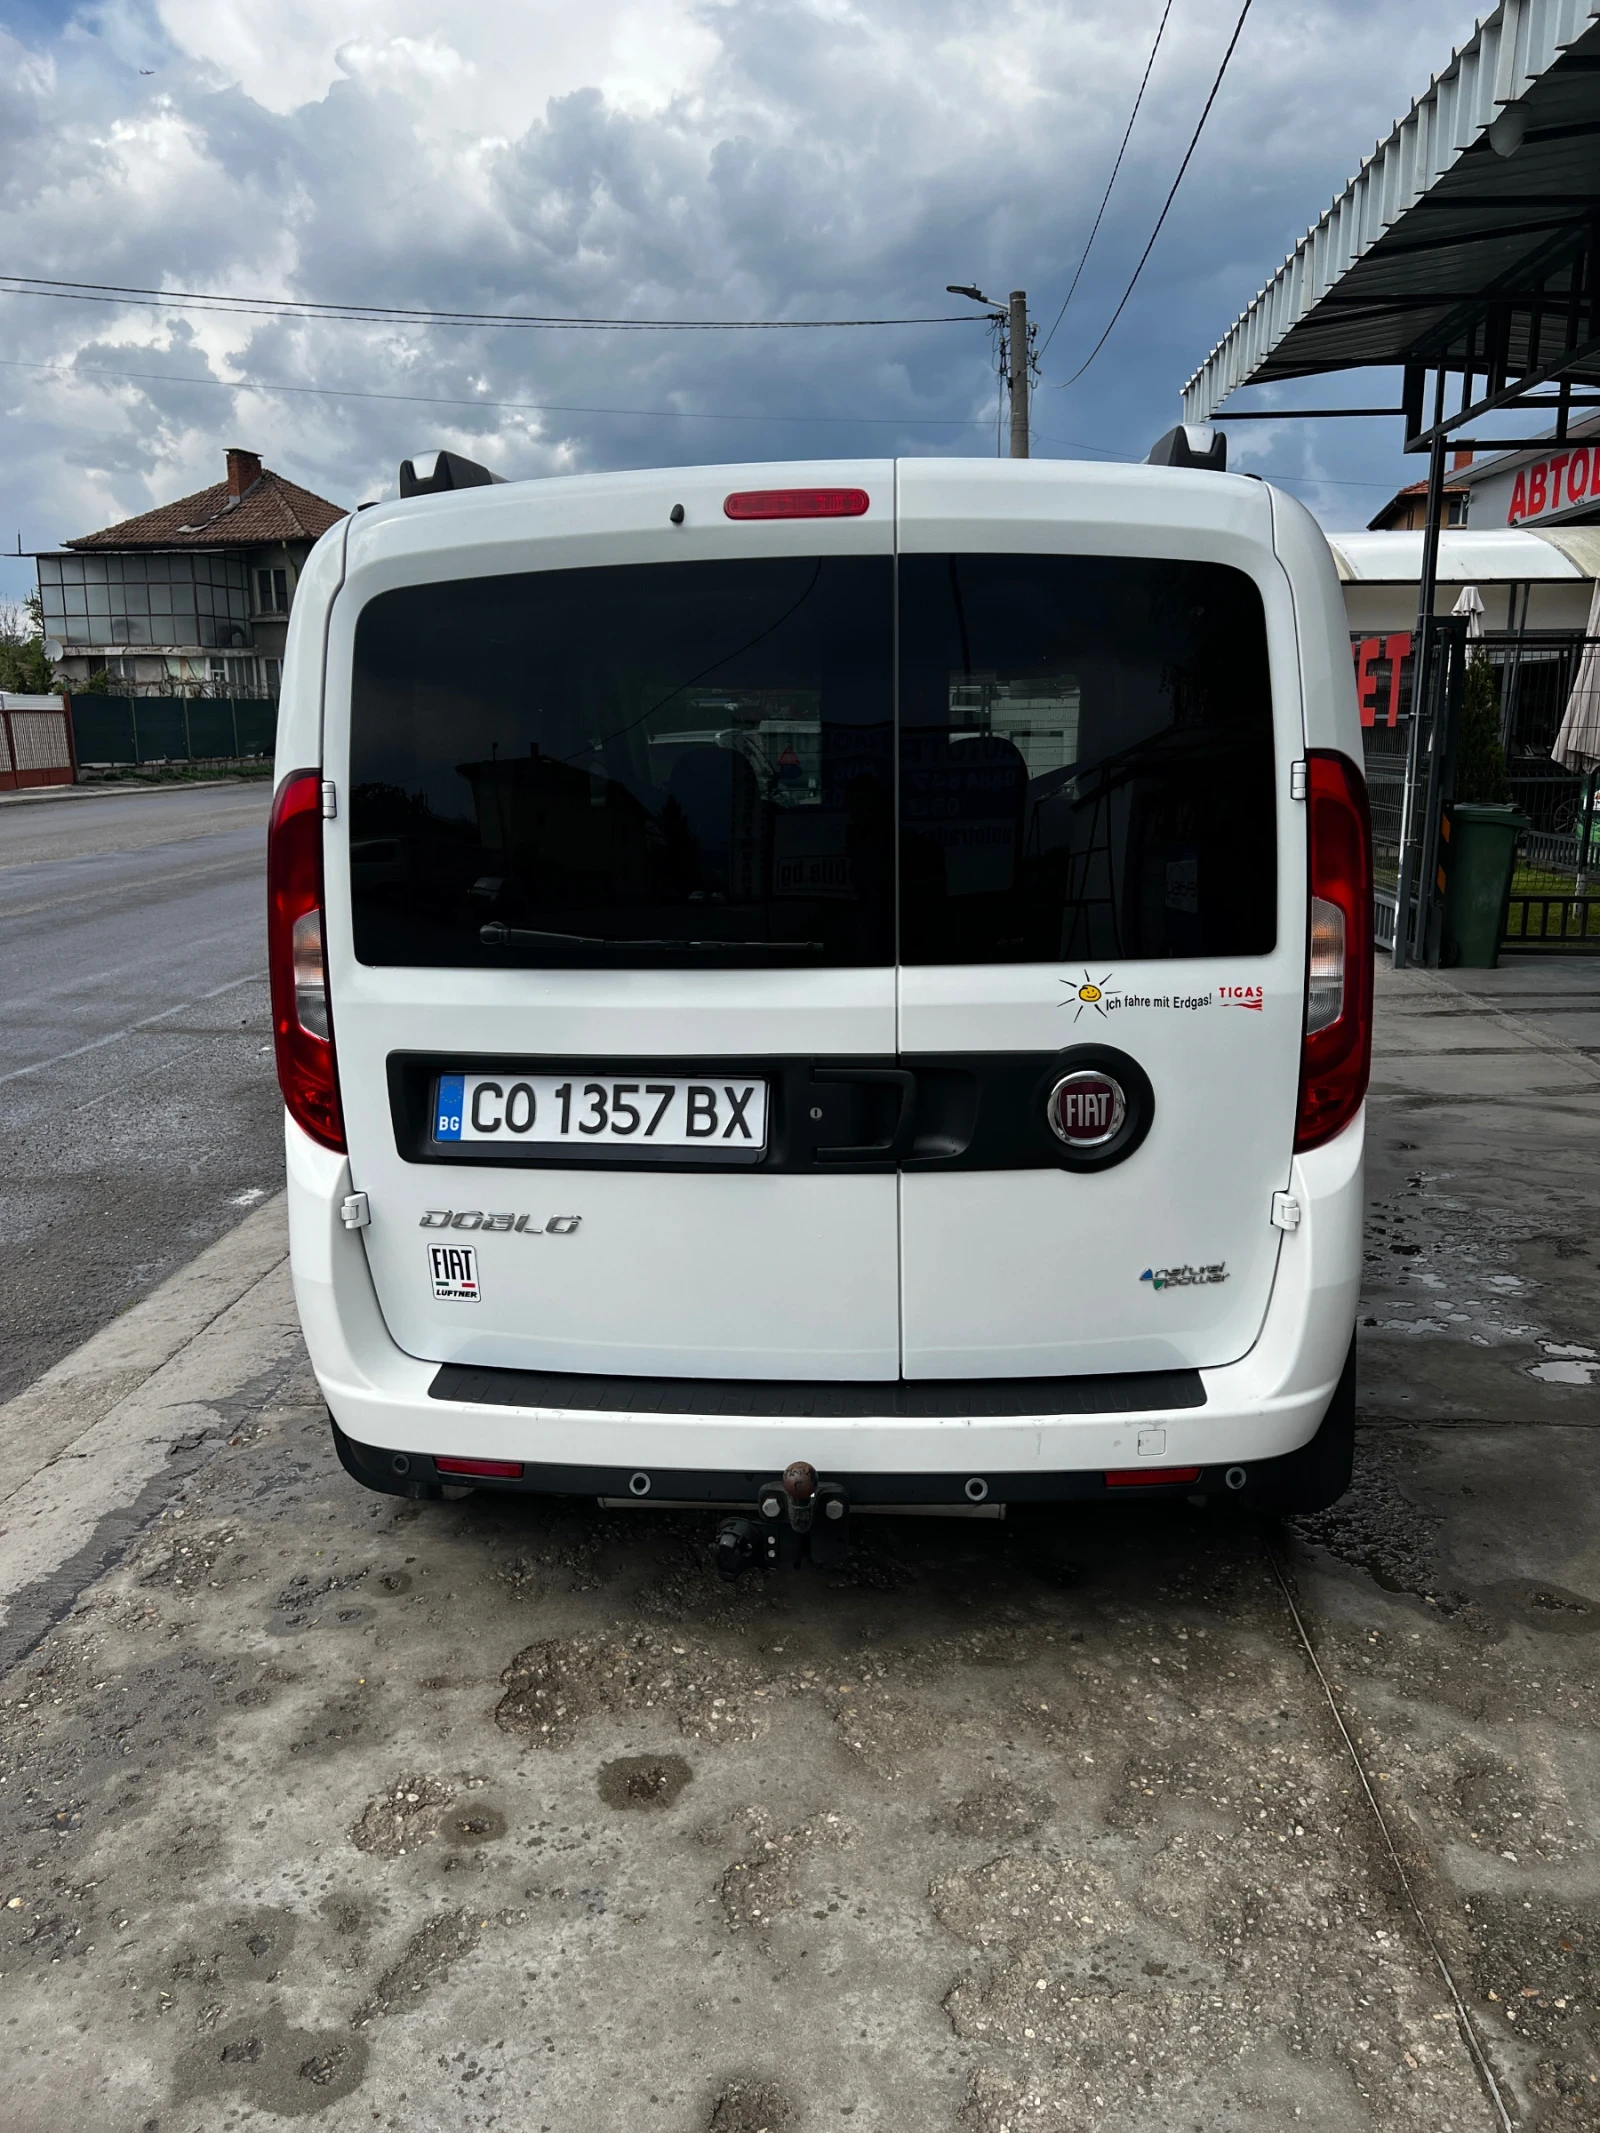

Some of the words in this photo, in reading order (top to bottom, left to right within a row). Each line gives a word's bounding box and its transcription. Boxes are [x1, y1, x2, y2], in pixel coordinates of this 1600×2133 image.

[1219, 986, 1263, 999] TIGAS
[1106, 997, 1121, 1011] Ich
[1125, 995, 1151, 1008] fahre
[1153, 996, 1170, 1008] mit
[1173, 993, 1212, 1011] Erdgas!
[1066, 1093, 1110, 1127] FIAT
[439, 1116, 460, 1131] BG
[431, 1248, 472, 1281] FIAT
[1155, 1261, 1226, 1277] natural
[1163, 1273, 1230, 1289] power
[436, 1289, 478, 1299] LUFTNER
